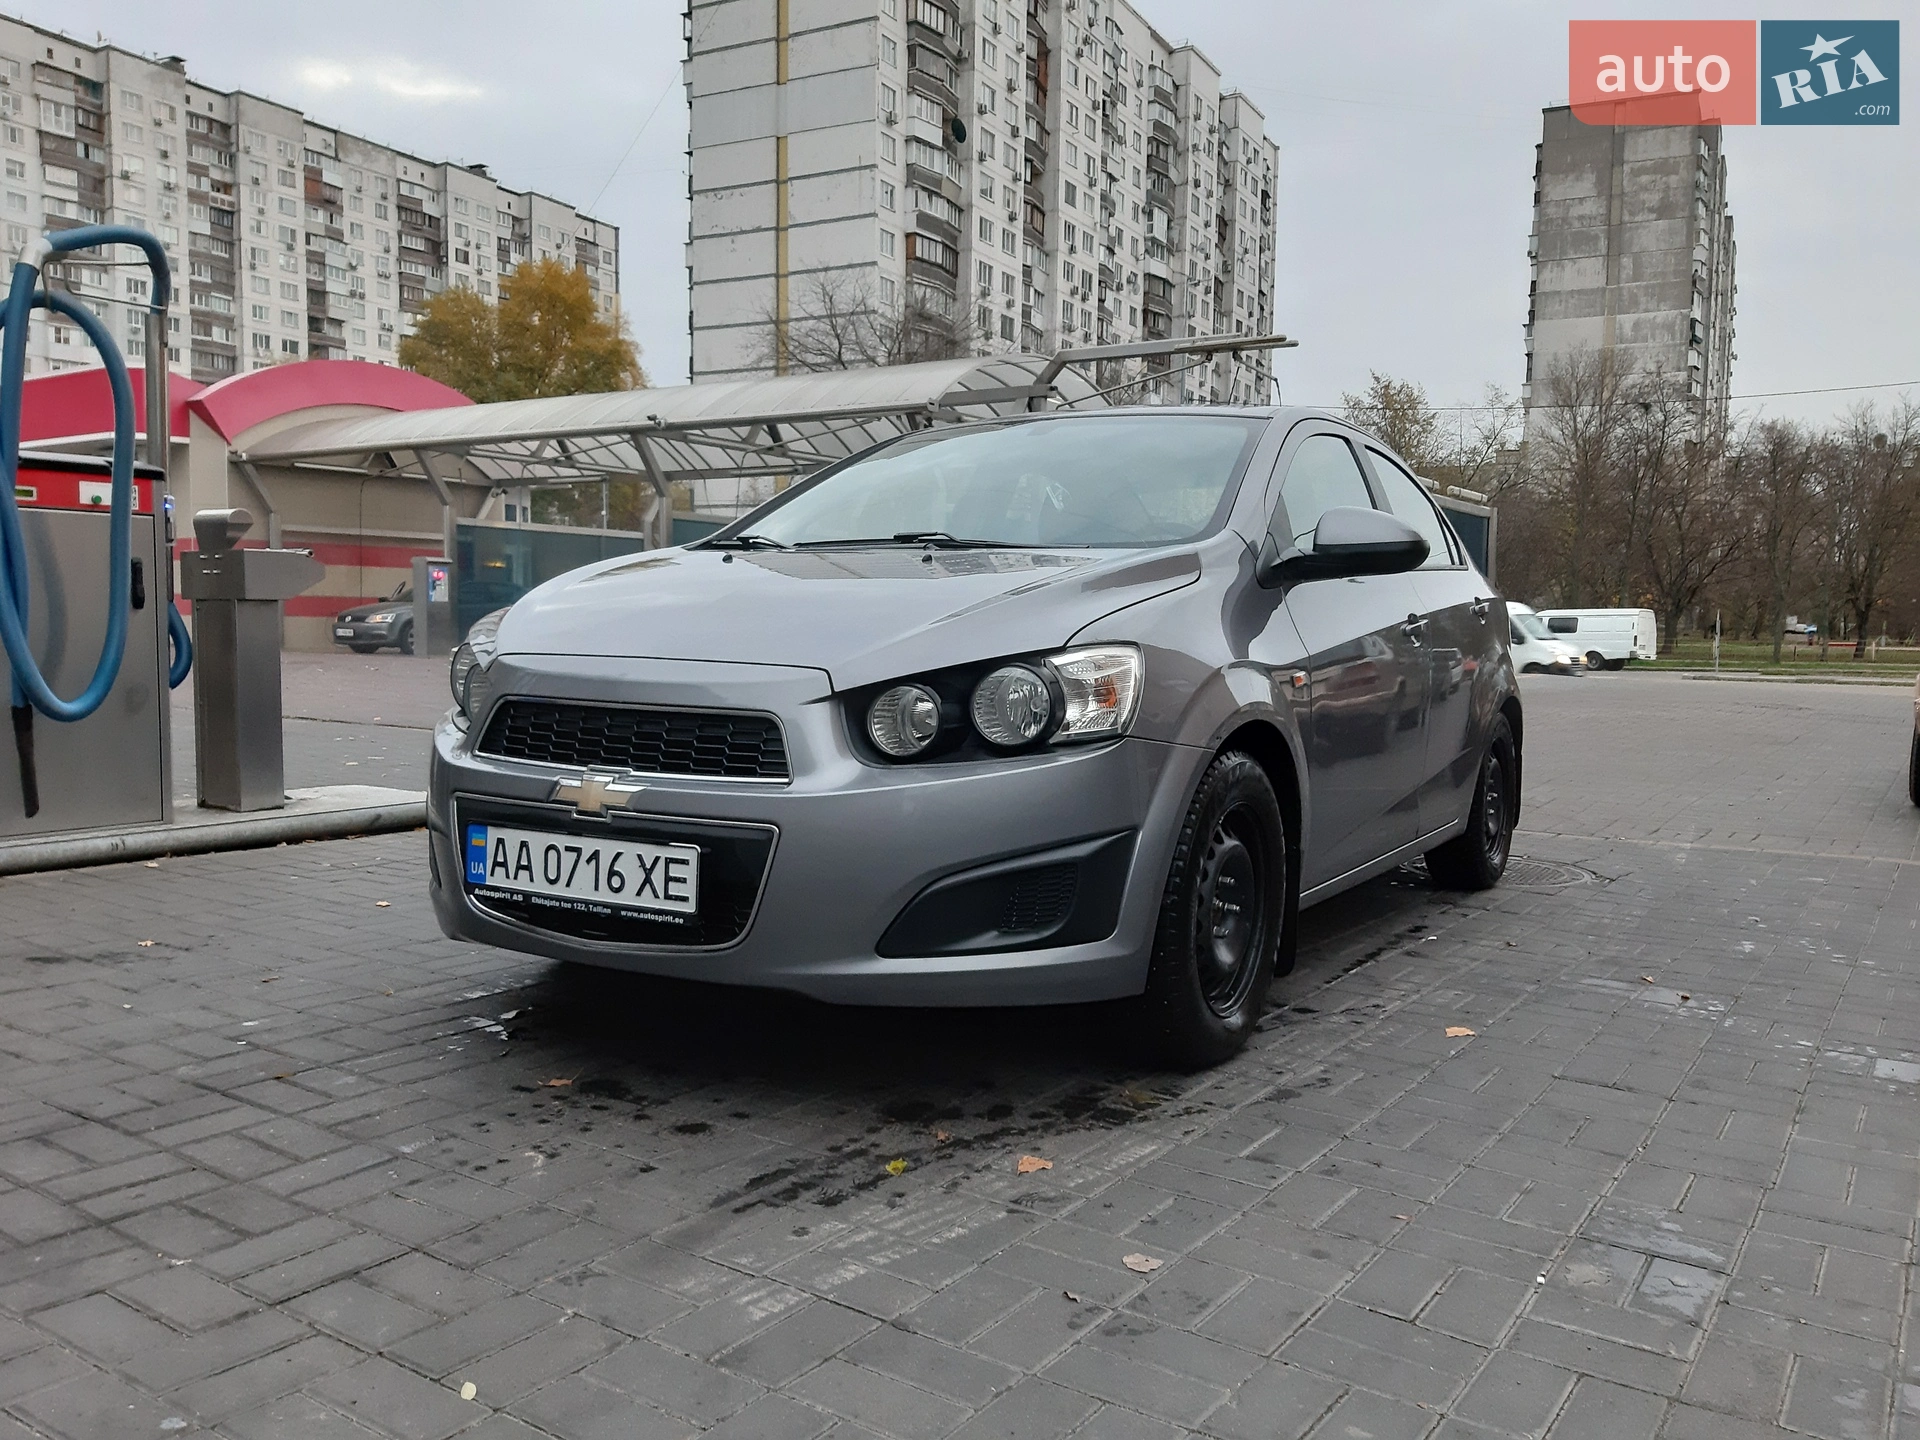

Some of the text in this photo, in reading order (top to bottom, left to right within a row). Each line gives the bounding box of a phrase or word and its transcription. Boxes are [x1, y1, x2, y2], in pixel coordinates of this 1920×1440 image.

[471, 861, 485, 875] UA
[489, 837, 690, 903] AA 0716 XE
[474, 887, 511, 899] Autospirit
[620, 909, 684, 924] www.autospirit.ee
